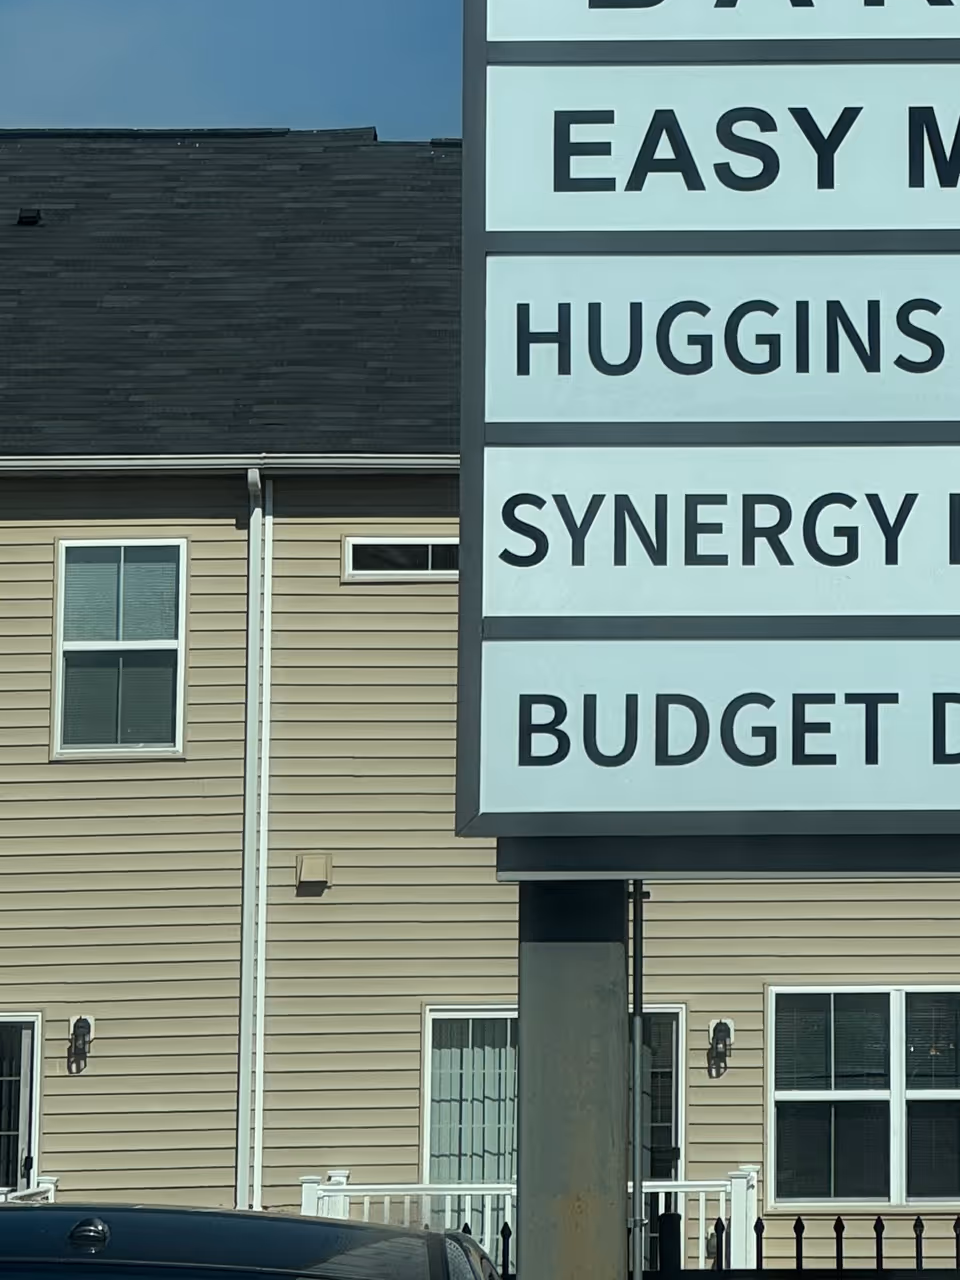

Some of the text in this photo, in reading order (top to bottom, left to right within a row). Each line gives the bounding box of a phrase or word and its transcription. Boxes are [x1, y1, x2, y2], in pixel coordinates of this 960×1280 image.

[553, 106, 864, 193] EASY
[516, 297, 945, 378] HUGGINS
[498, 492, 919, 569] SYNERGY
[518, 691, 900, 768] BUDGET
